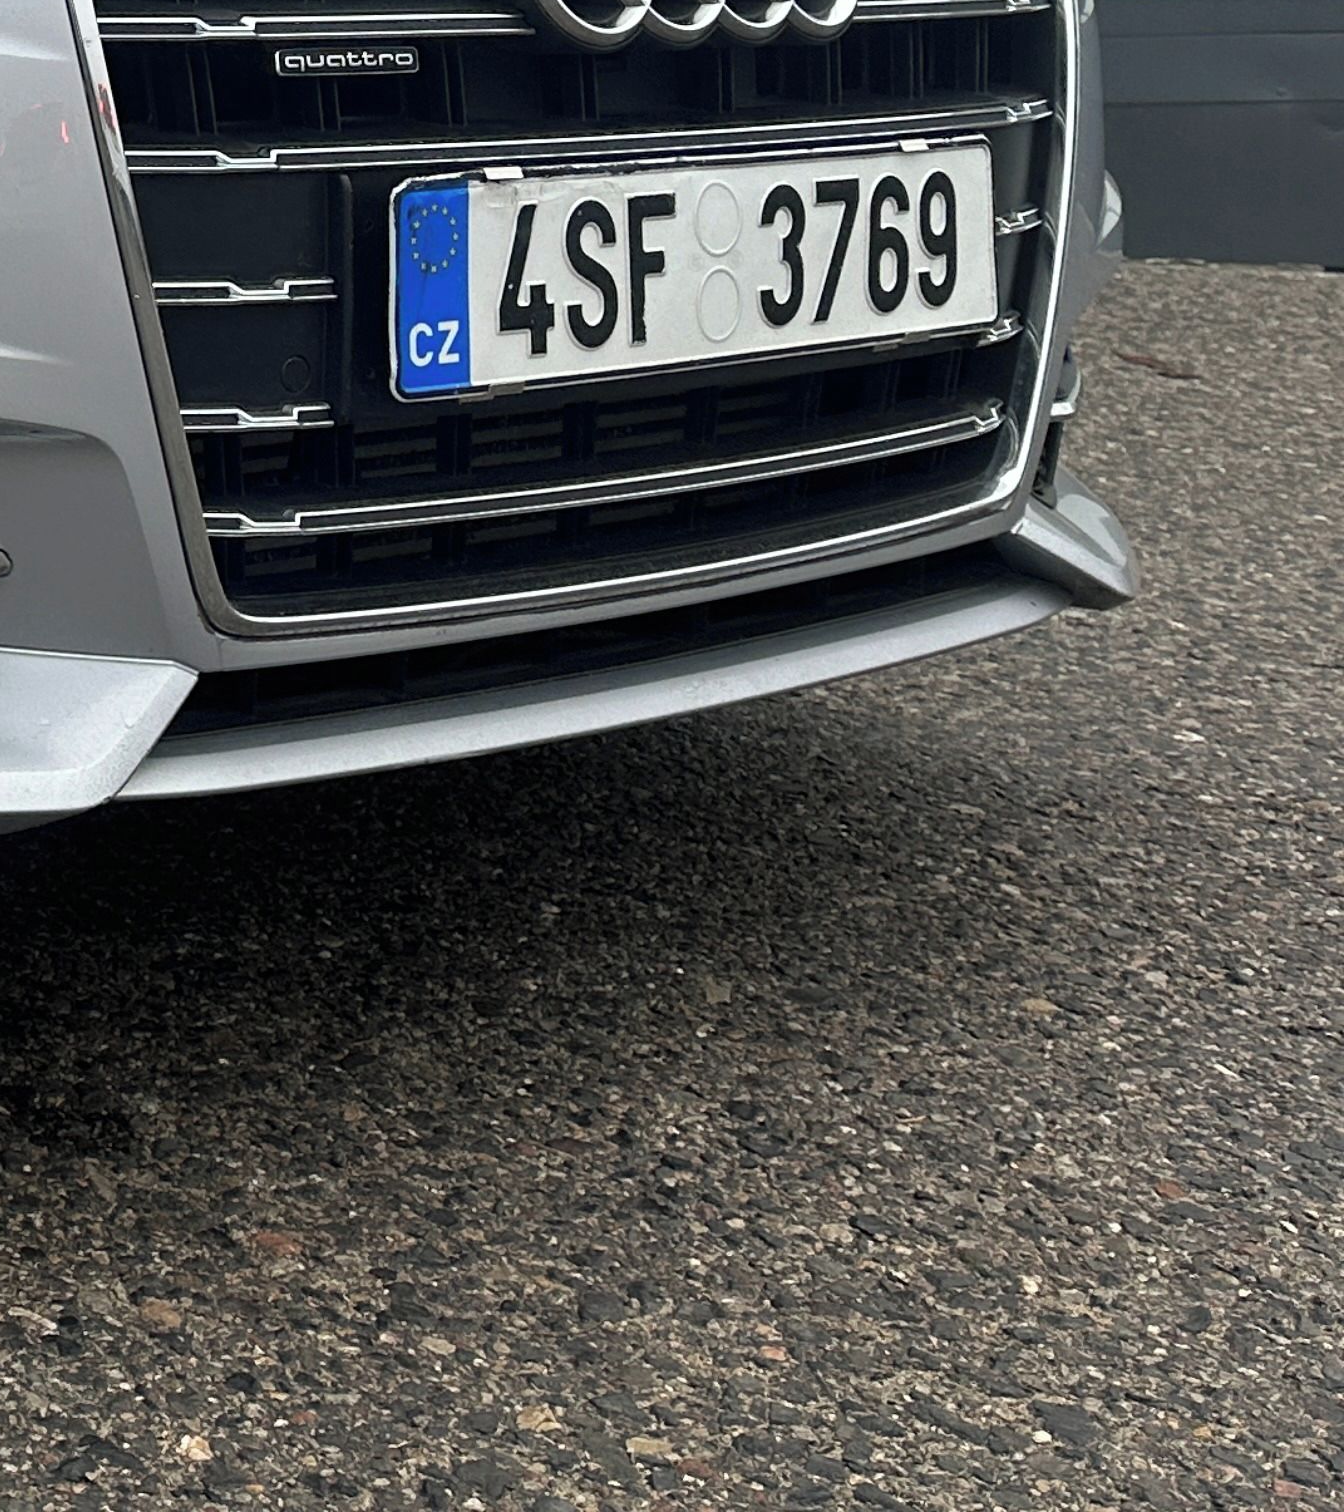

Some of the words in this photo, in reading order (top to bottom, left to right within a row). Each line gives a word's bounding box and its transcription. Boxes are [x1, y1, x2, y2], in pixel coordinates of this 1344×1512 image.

[284, 50, 414, 73] quattro
[497, 191, 677, 357] 4SF
[758, 169, 958, 327] 3769
[408, 319, 461, 368] CZ
